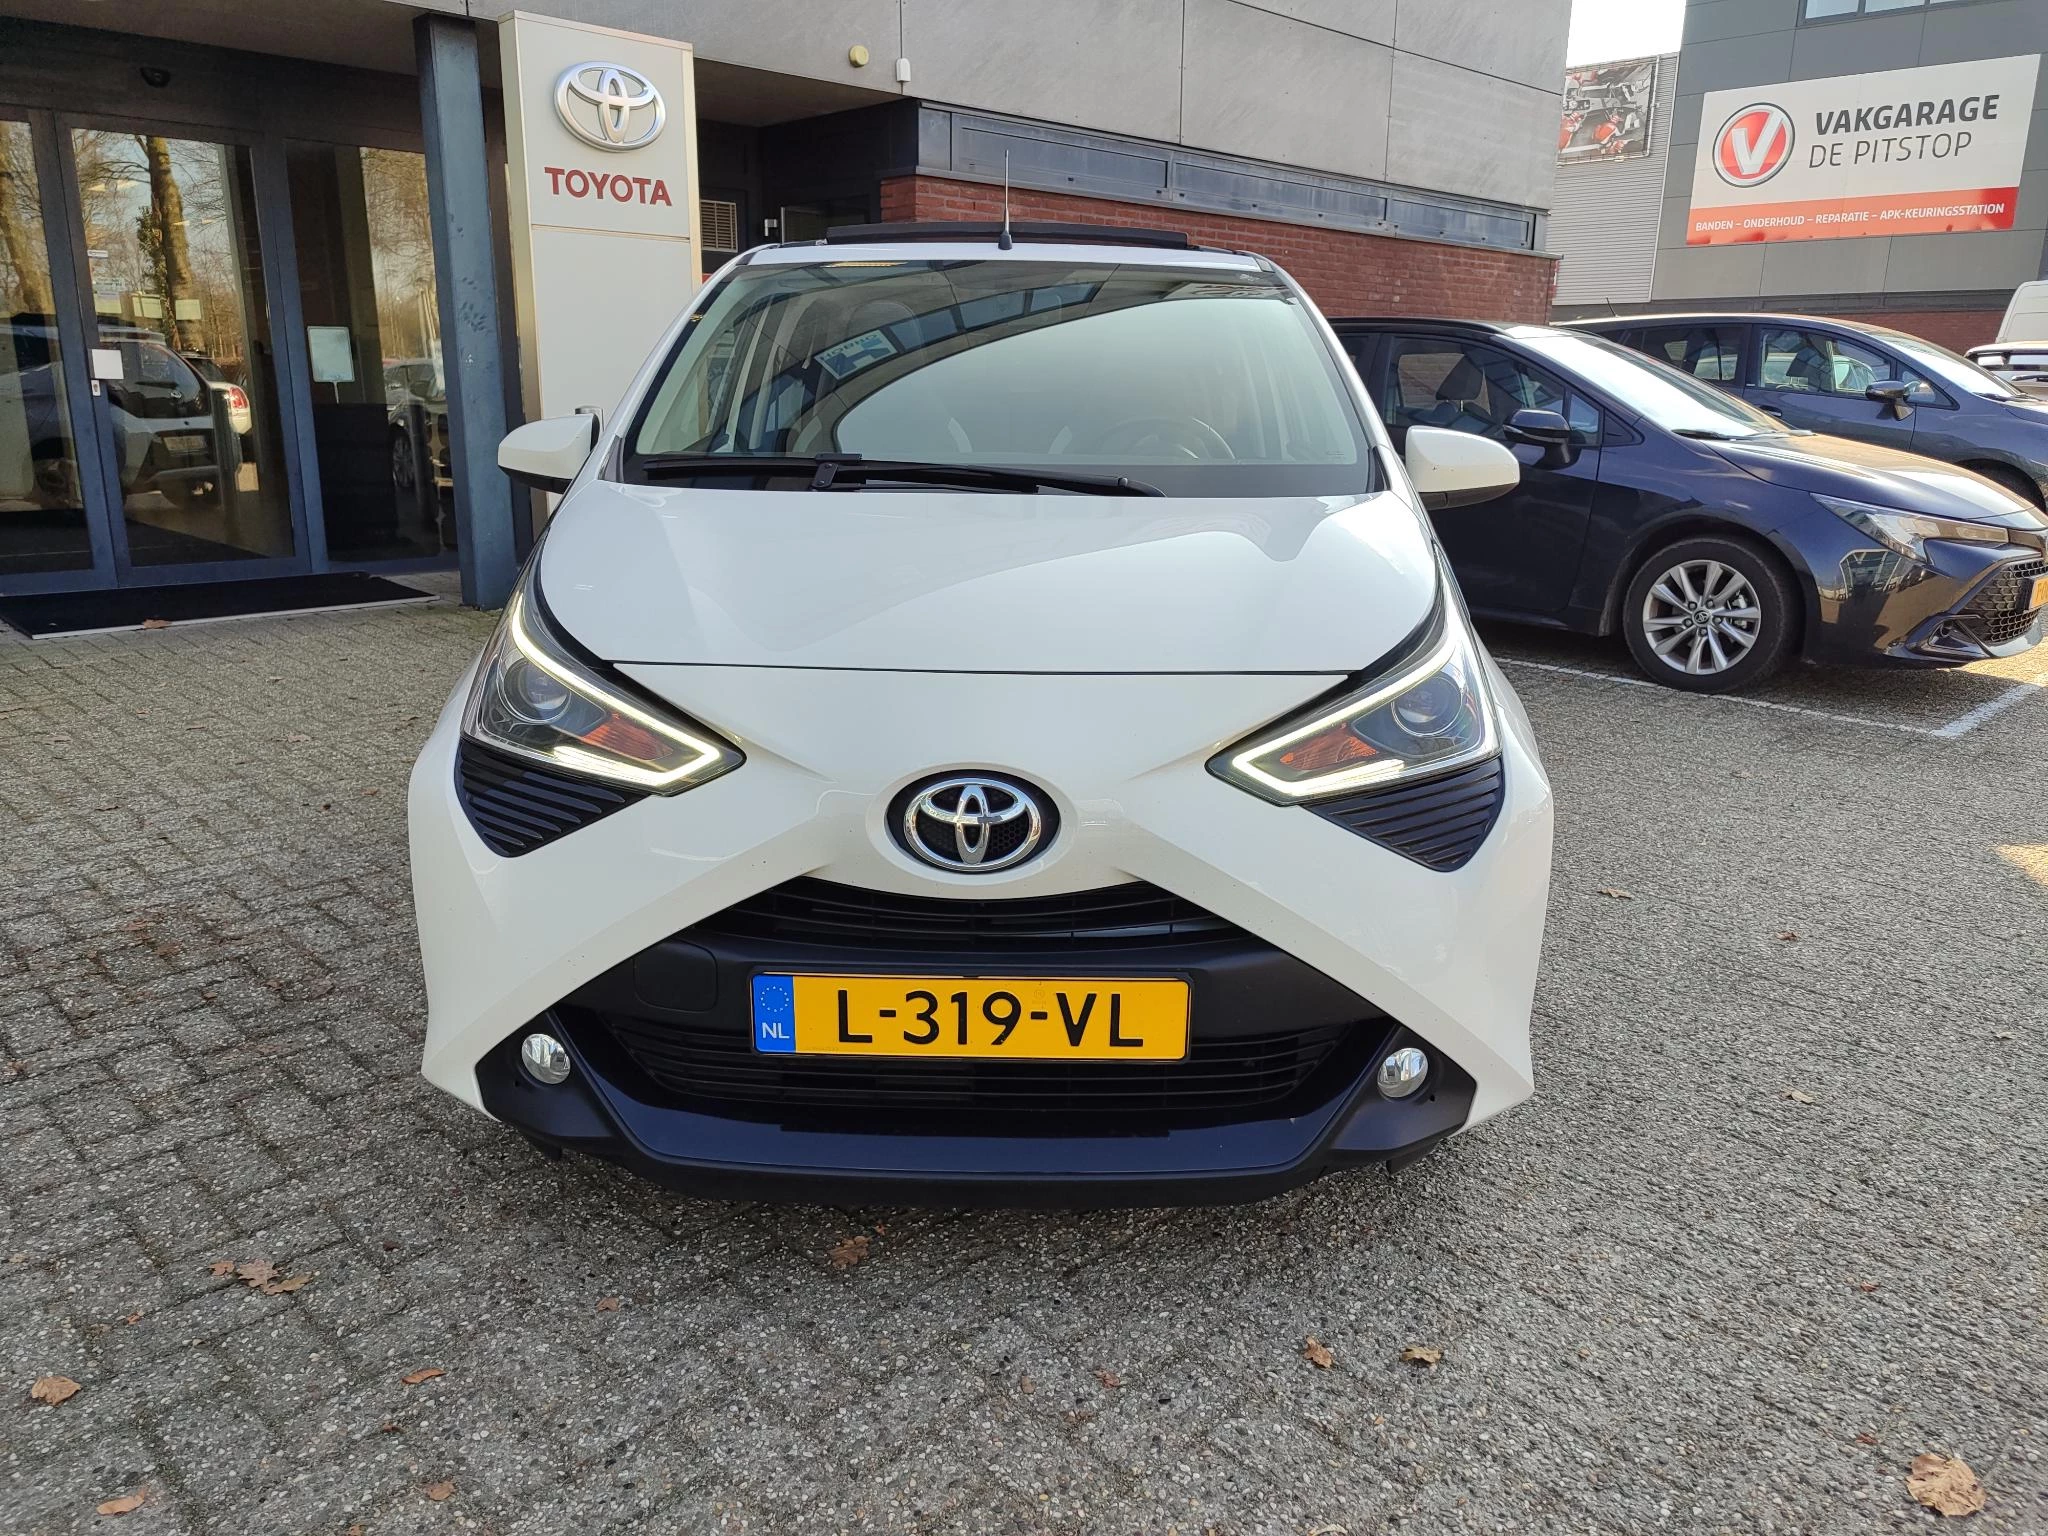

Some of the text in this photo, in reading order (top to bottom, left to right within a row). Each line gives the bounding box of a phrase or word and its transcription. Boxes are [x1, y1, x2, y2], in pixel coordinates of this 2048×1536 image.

[1816, 95, 2000, 135] VAKGARAGE
[1809, 132, 1972, 168] DE PITSTOP
[544, 166, 672, 206] TOYOTA
[1695, 220, 1734, 232] BANDEN
[1743, 215, 1805, 229] ONDERHOUD
[1815, 211, 1869, 224] REPARATIE
[1880, 203, 2005, 220] APK-KEURINGSSTATION
[761, 1022, 790, 1039] NL
[837, 989, 1144, 1047] L-319-VL
